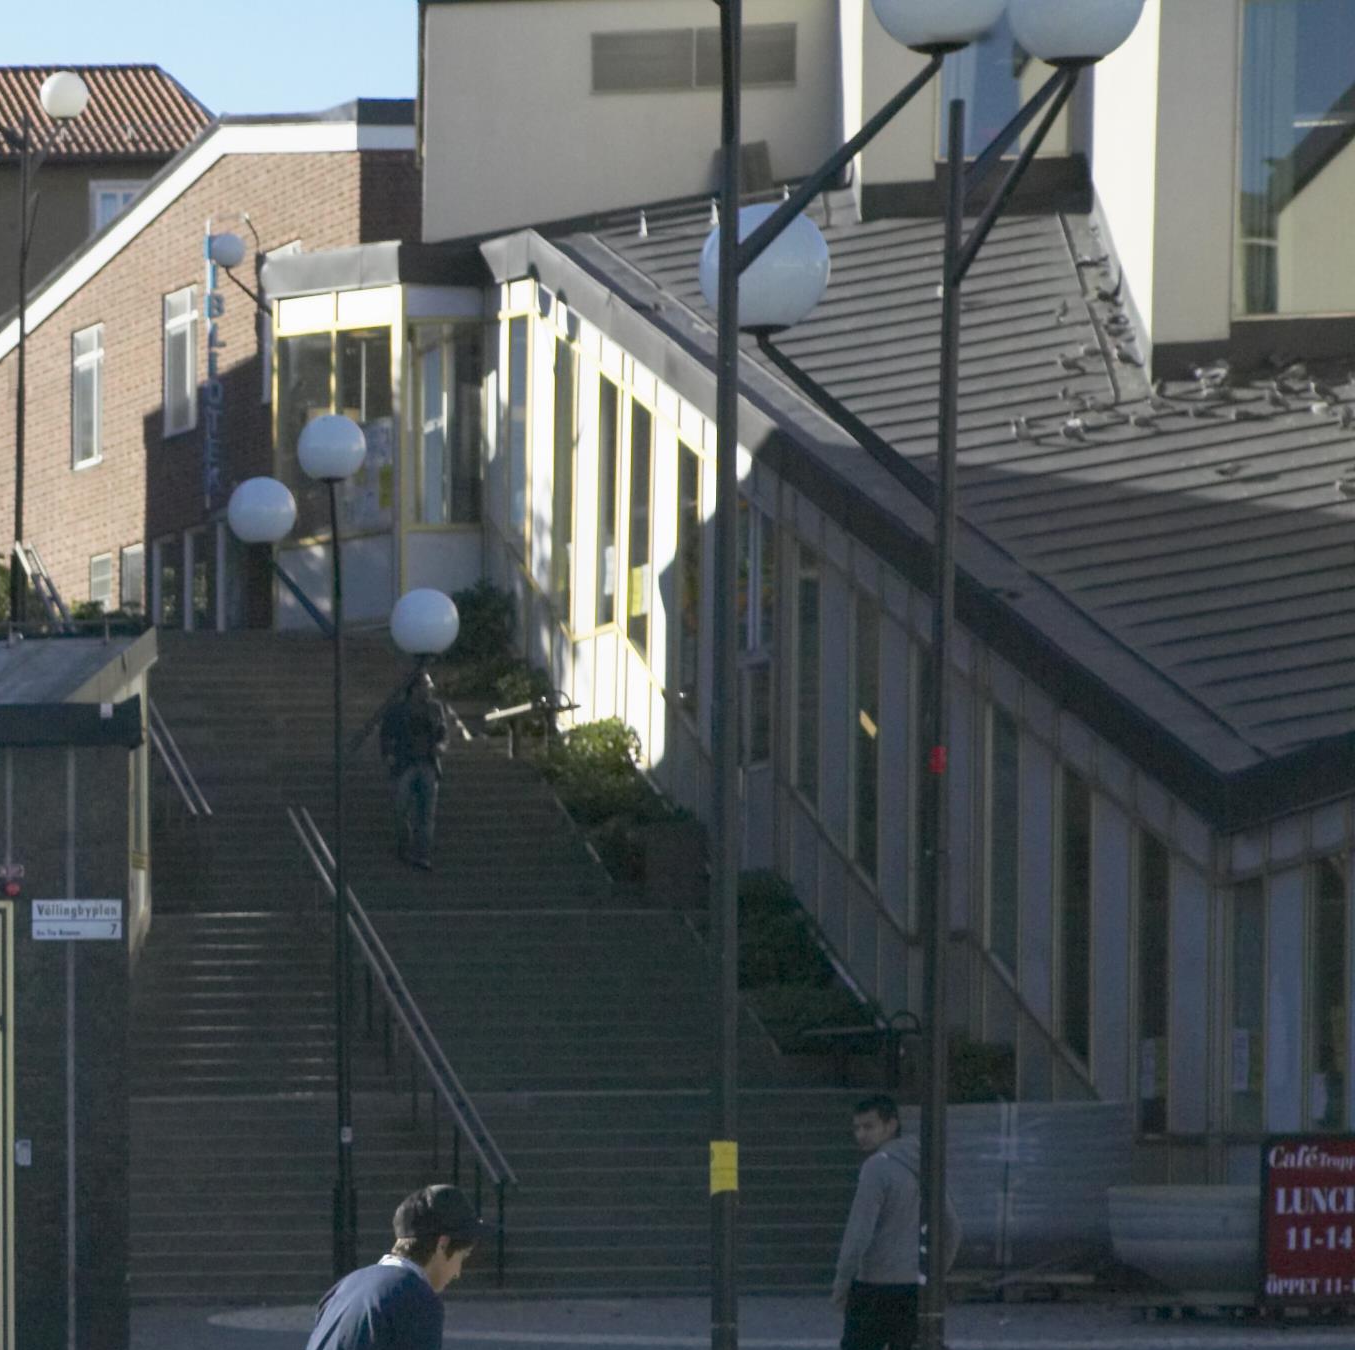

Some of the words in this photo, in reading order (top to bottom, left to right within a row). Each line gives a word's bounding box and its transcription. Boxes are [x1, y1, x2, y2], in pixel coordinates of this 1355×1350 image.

[203, 234, 228, 487] IBLIOTEK
[110, 923, 118, 936] 7
[1268, 1144, 1318, 1169] Café
